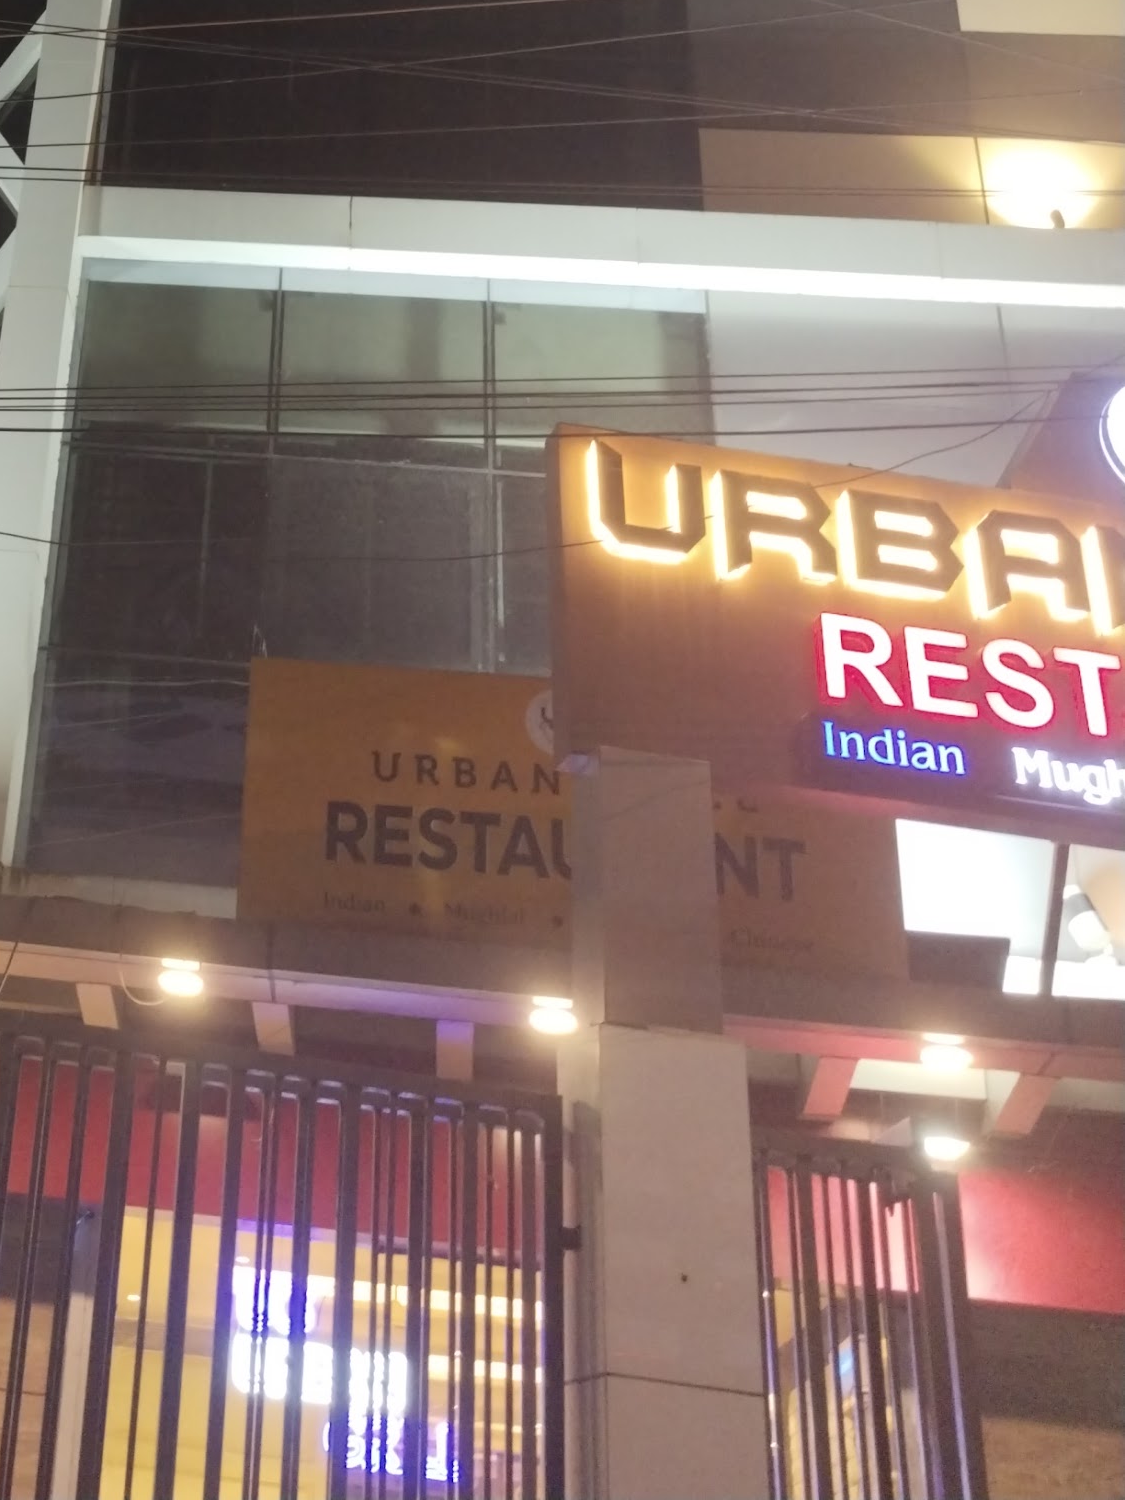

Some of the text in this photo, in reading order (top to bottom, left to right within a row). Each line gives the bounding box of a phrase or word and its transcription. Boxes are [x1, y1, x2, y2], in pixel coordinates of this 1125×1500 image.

[817, 611, 1122, 738] REST
[372, 750, 561, 796] URBAN
[821, 721, 966, 775] Indian
